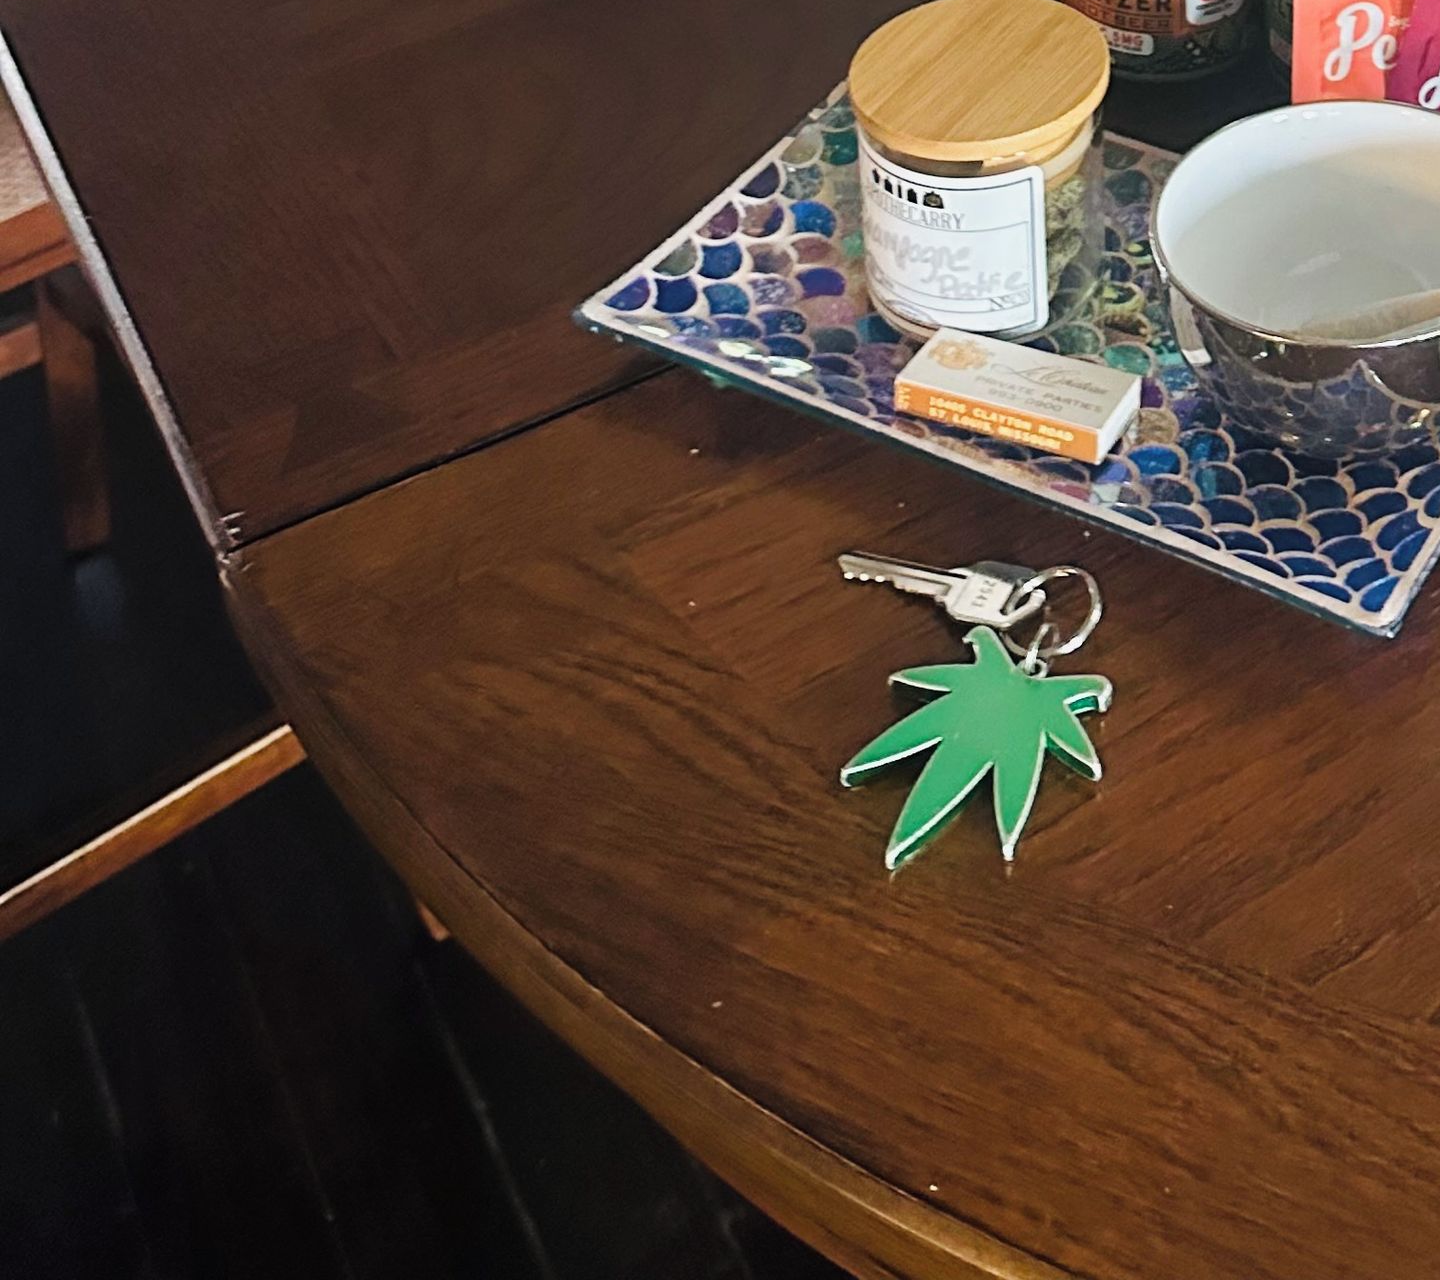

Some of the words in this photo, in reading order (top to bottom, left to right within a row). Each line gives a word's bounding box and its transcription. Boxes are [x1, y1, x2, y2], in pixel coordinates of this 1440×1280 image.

[1042, 391, 1104, 413] PARTIES
[972, 406, 1033, 431] CLAYTON
[1038, 423, 1074, 443] ROAD
